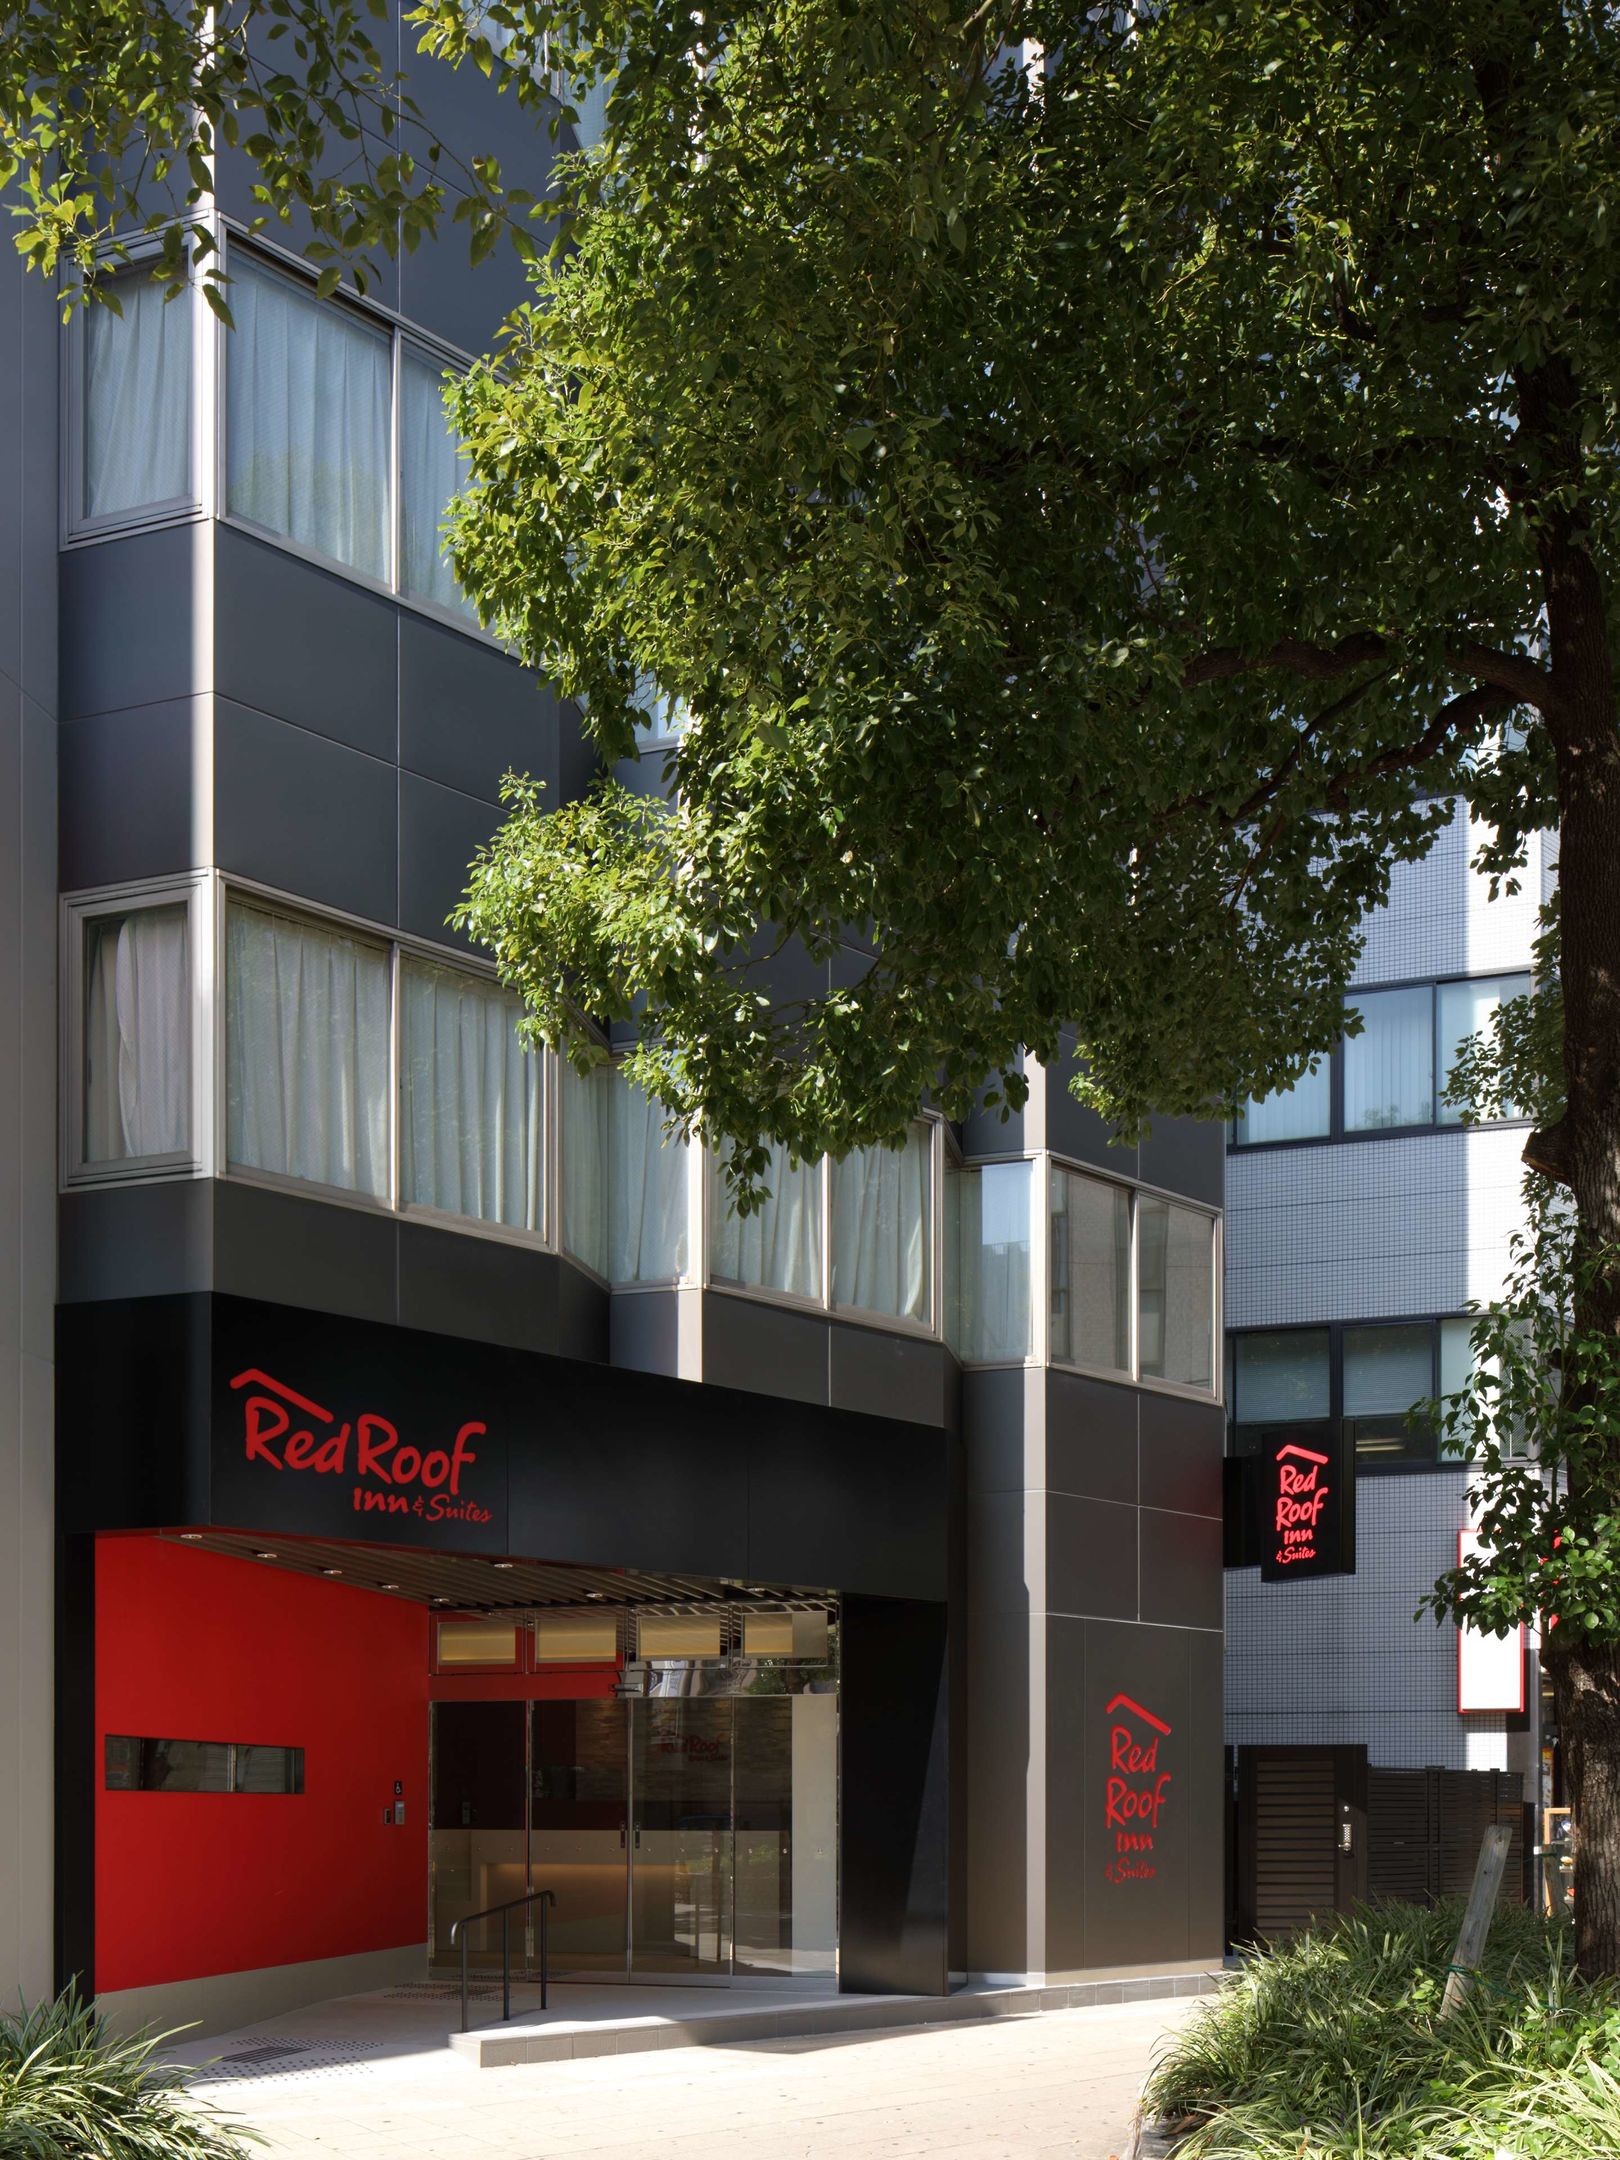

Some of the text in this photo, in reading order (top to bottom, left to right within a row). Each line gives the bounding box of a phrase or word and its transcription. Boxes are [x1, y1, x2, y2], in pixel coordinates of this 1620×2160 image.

[1279, 1464, 1319, 1496] Red
[353, 1487, 492, 1522] Inn & Suites
[1275, 1486, 1329, 1532] Roof
[1283, 1528, 1314, 1545] Inn
[1282, 1545, 1317, 1565] Suites
[1110, 1724, 1159, 1774] Red
[1104, 1771, 1173, 1830] Roof
[1114, 1830, 1153, 1852] Inn
